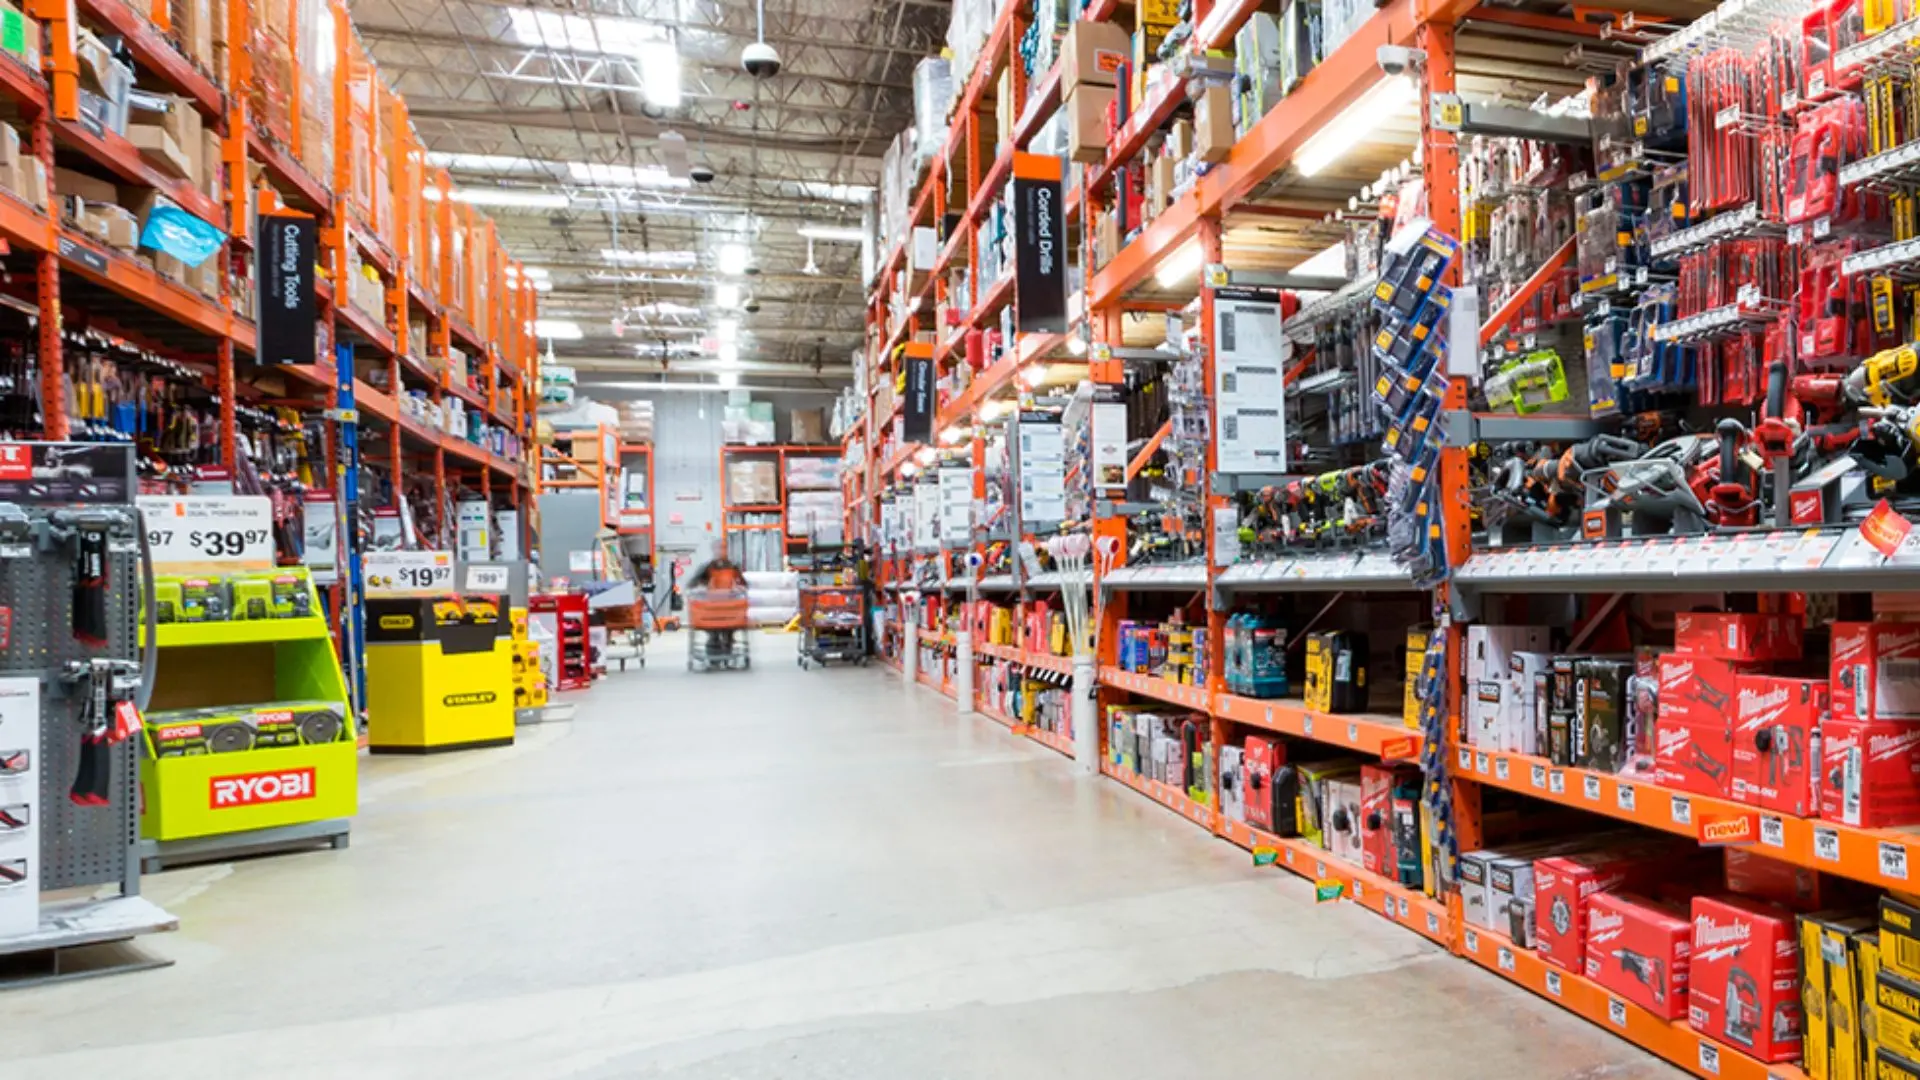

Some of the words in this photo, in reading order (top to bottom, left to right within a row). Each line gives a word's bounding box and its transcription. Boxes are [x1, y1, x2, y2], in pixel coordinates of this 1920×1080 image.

[1038, 187, 1052, 239] Corded
[281, 224, 300, 272] Cutting
[1040, 240, 1053, 275] Drills
[284, 274, 300, 309] Tools
[443, 691, 497, 707] STANLEY
[1737, 684, 1790, 720] Milwaukee
[161, 725, 201, 738] RYOBI
[256, 711, 293, 724] RYOBI
[213, 772, 312, 805] RYOBI
[1705, 817, 1746, 837] new!
[1695, 913, 1752, 949] Milwaukee
